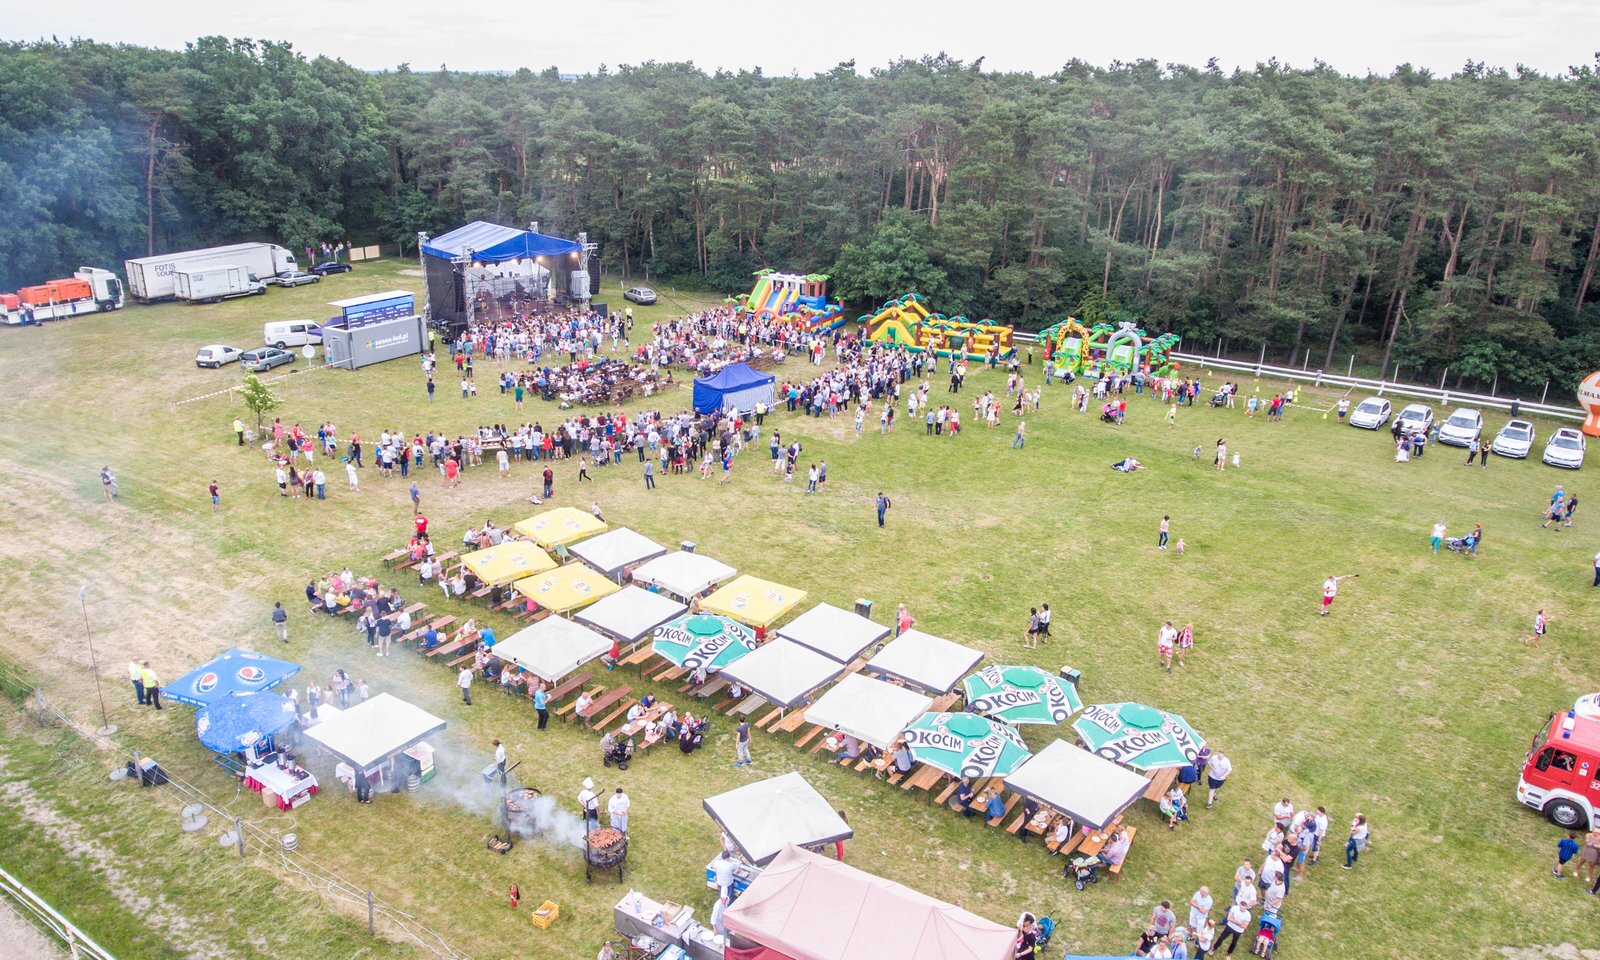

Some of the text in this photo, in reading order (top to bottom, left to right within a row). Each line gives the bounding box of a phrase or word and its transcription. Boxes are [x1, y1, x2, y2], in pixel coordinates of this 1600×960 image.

[154, 262, 176, 272] FOTIS
[653, 627, 692, 644] OKOCIM
[681, 634, 731, 668] OKOCIM
[968, 690, 1038, 712] OKOCIM
[1083, 705, 1121, 731] OKOCIM
[901, 730, 962, 750] OKOCIM
[1094, 732, 1167, 762] OKOCIM
[960, 734, 1003, 778] OKOCIM
